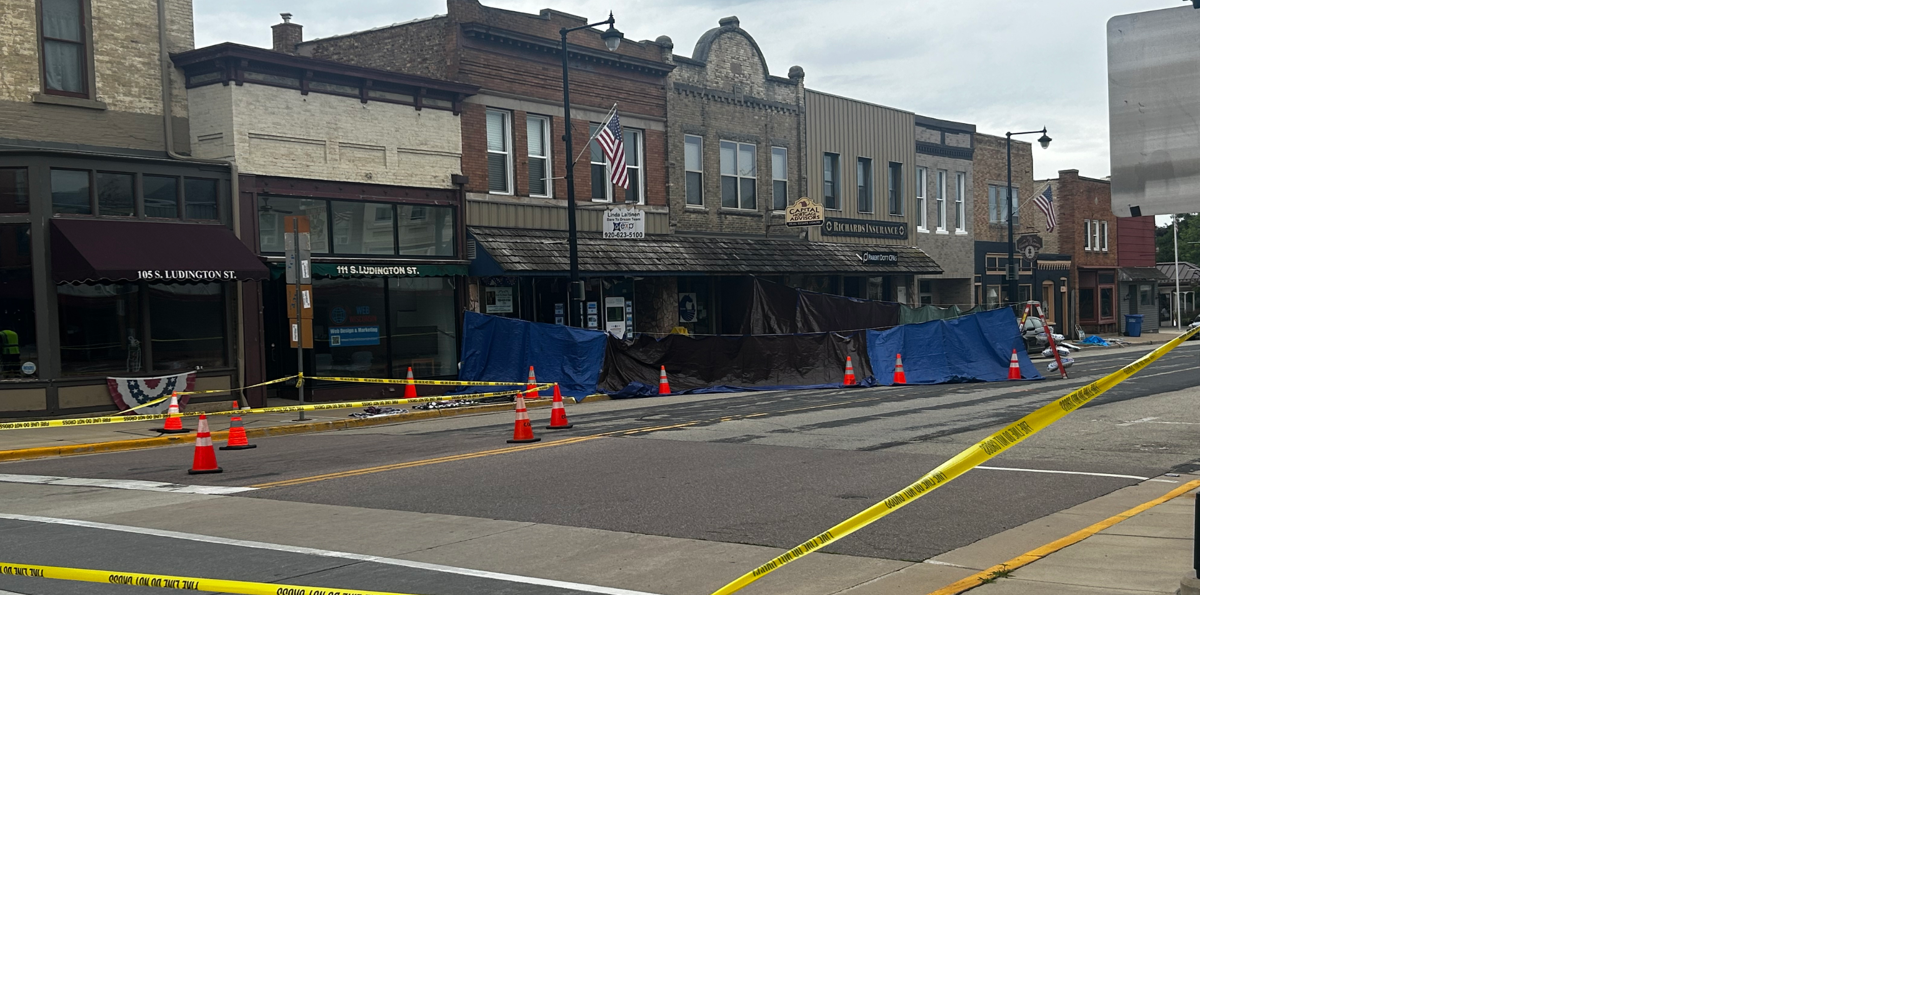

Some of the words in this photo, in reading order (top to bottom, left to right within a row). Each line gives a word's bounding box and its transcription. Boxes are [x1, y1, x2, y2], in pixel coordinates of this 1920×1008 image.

[834, 222, 865, 233] RICHARDS
[866, 224, 898, 234] INSURANCE
[137, 270, 153, 279] 105
[154, 270, 163, 279] S.
[165, 270, 222, 279] LUDINGTON
[223, 270, 237, 279] ST.
[337, 266, 348, 274] 111
[350, 266, 358, 274] S.
[359, 266, 405, 275] LUDINGTON
[406, 267, 420, 275] ST.
[356, 306, 370, 314] WEB
